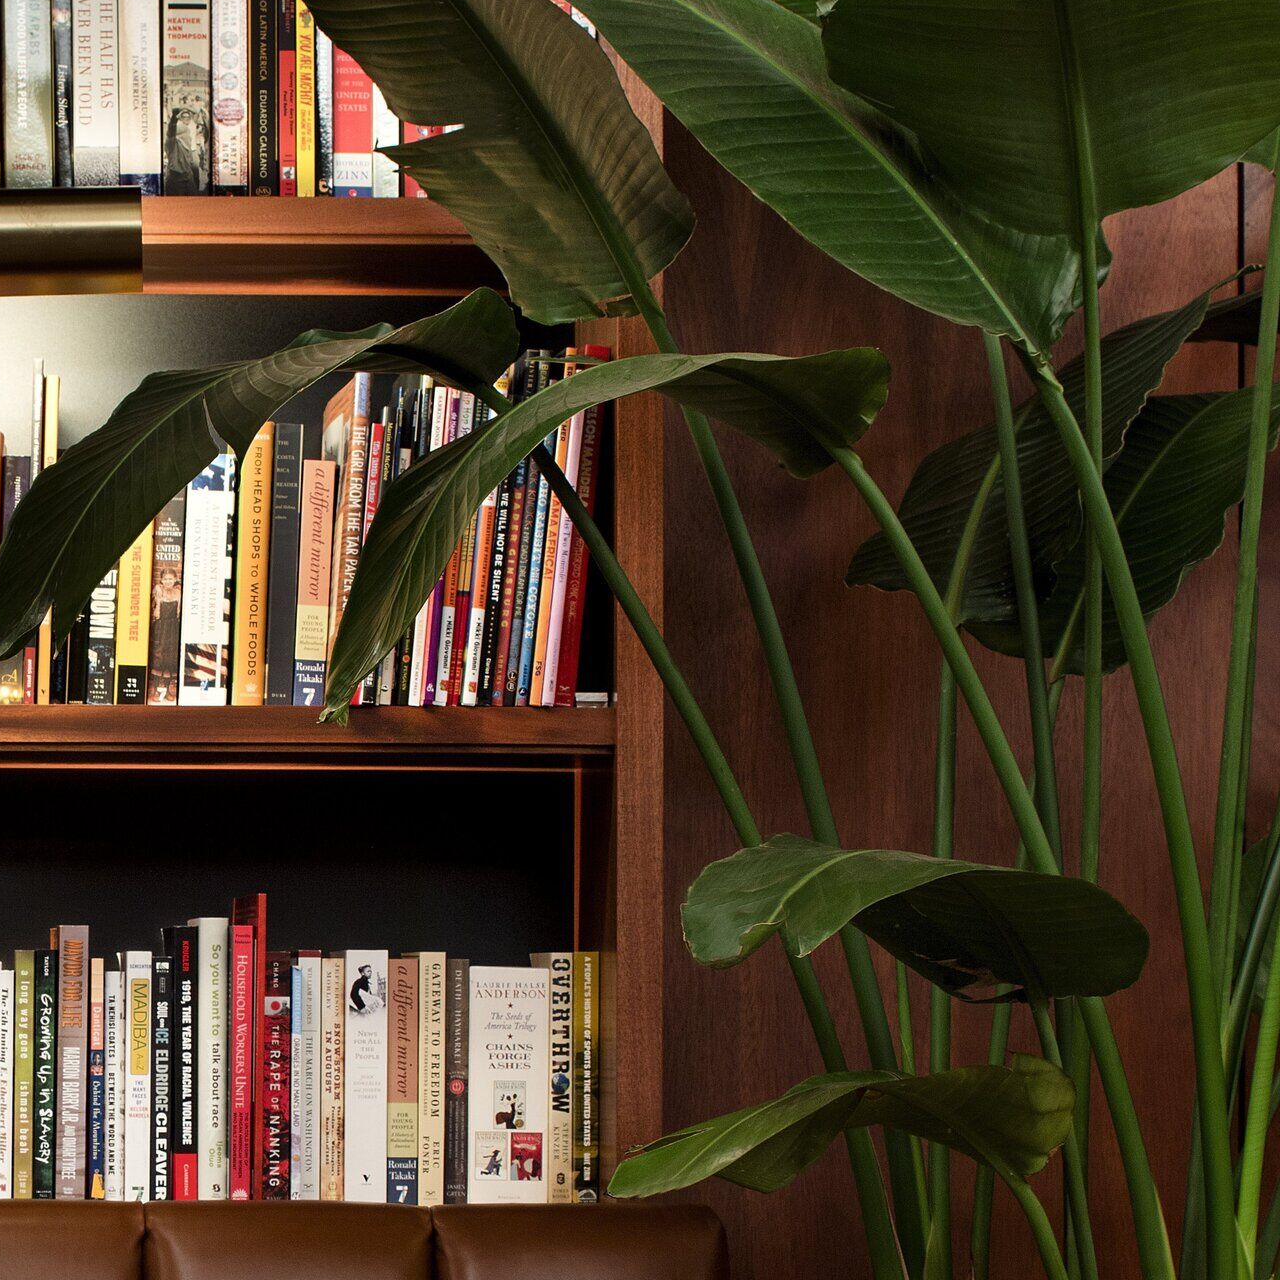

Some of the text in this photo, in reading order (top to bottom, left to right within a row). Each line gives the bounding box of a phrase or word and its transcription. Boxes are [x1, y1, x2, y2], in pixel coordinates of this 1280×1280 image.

[78, 35, 91, 77] BEEN
[100, 30, 113, 71] HALF
[78, 83, 91, 125] TOLD
[101, 77, 113, 109] HAS
[247, 447, 262, 676] FROM HEAD SHOPS TO WHOLE FOODS
[475, 989, 546, 999] ANDERSON
[133, 983, 147, 1050] MADIBA
[485, 1043, 533, 1051] CHAINS
[488, 1053, 530, 1061] FORGE
[488, 1062, 531, 1070] ASHES
